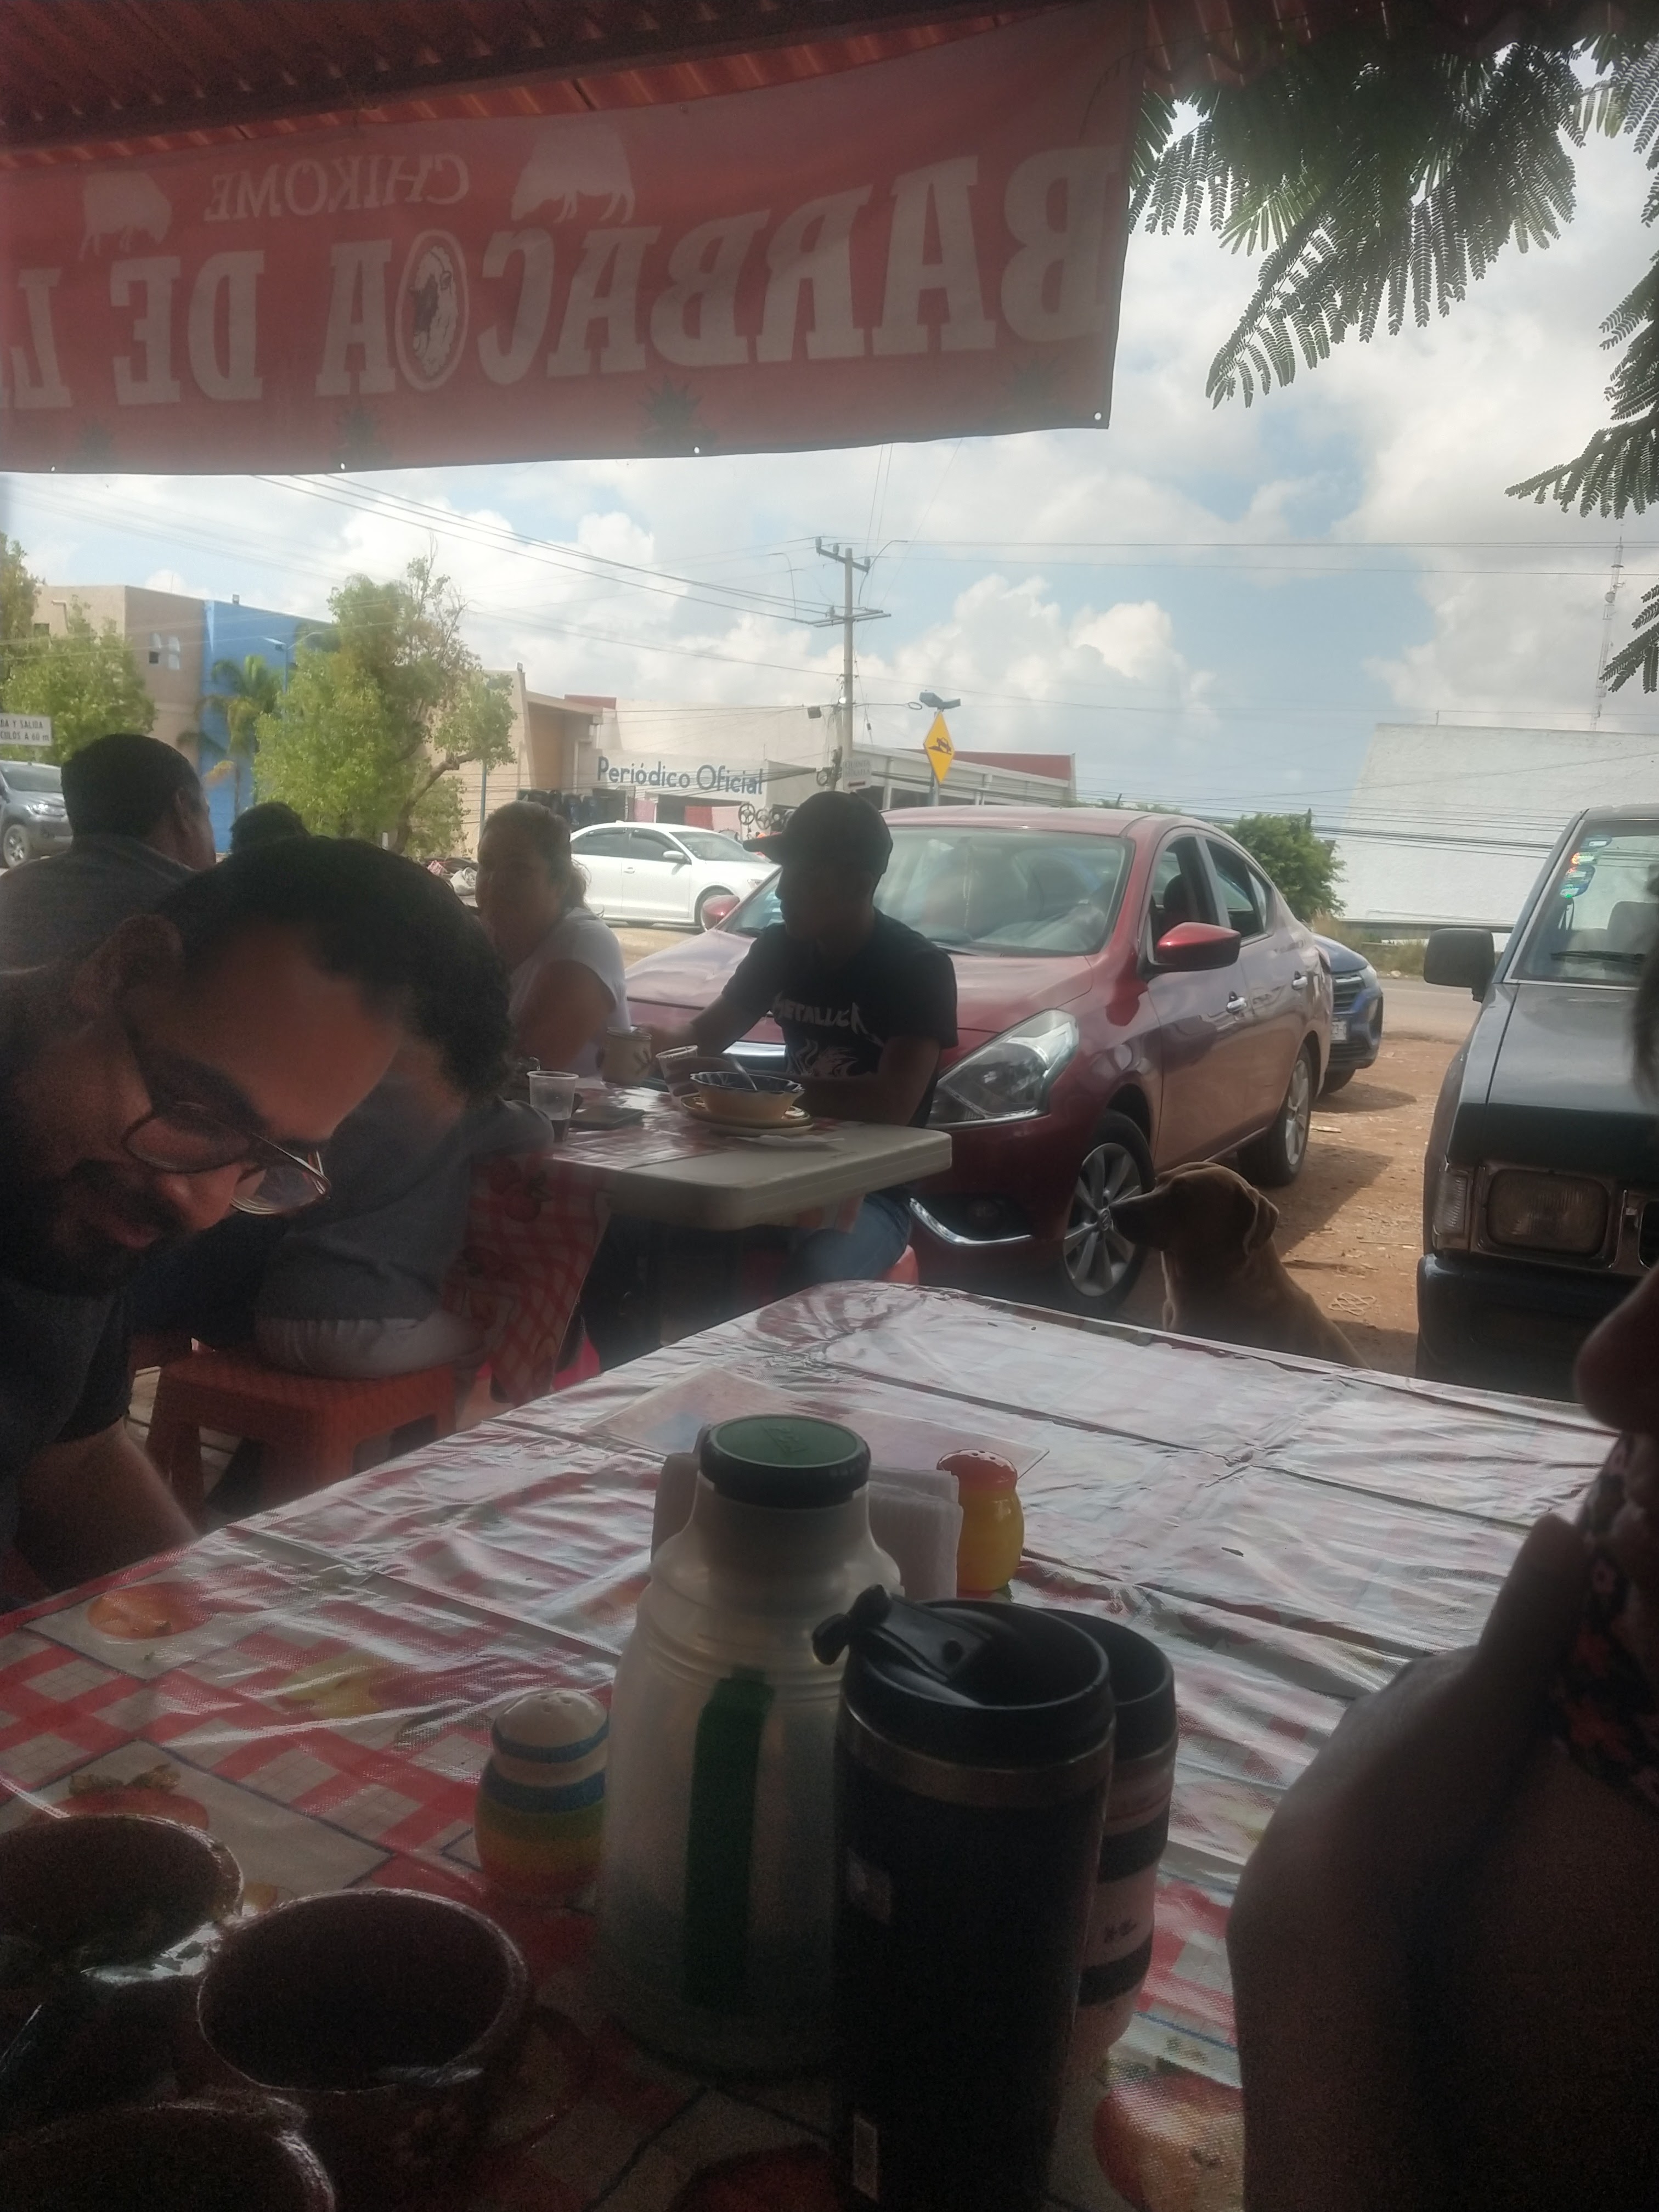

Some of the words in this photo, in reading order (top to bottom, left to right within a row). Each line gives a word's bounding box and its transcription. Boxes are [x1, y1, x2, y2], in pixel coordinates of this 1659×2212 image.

[13, 720, 16, 728] Y
[20, 720, 43, 729] SALIDA
[597, 755, 690, 788] Periódico
[696, 764, 763, 794] Oficial
